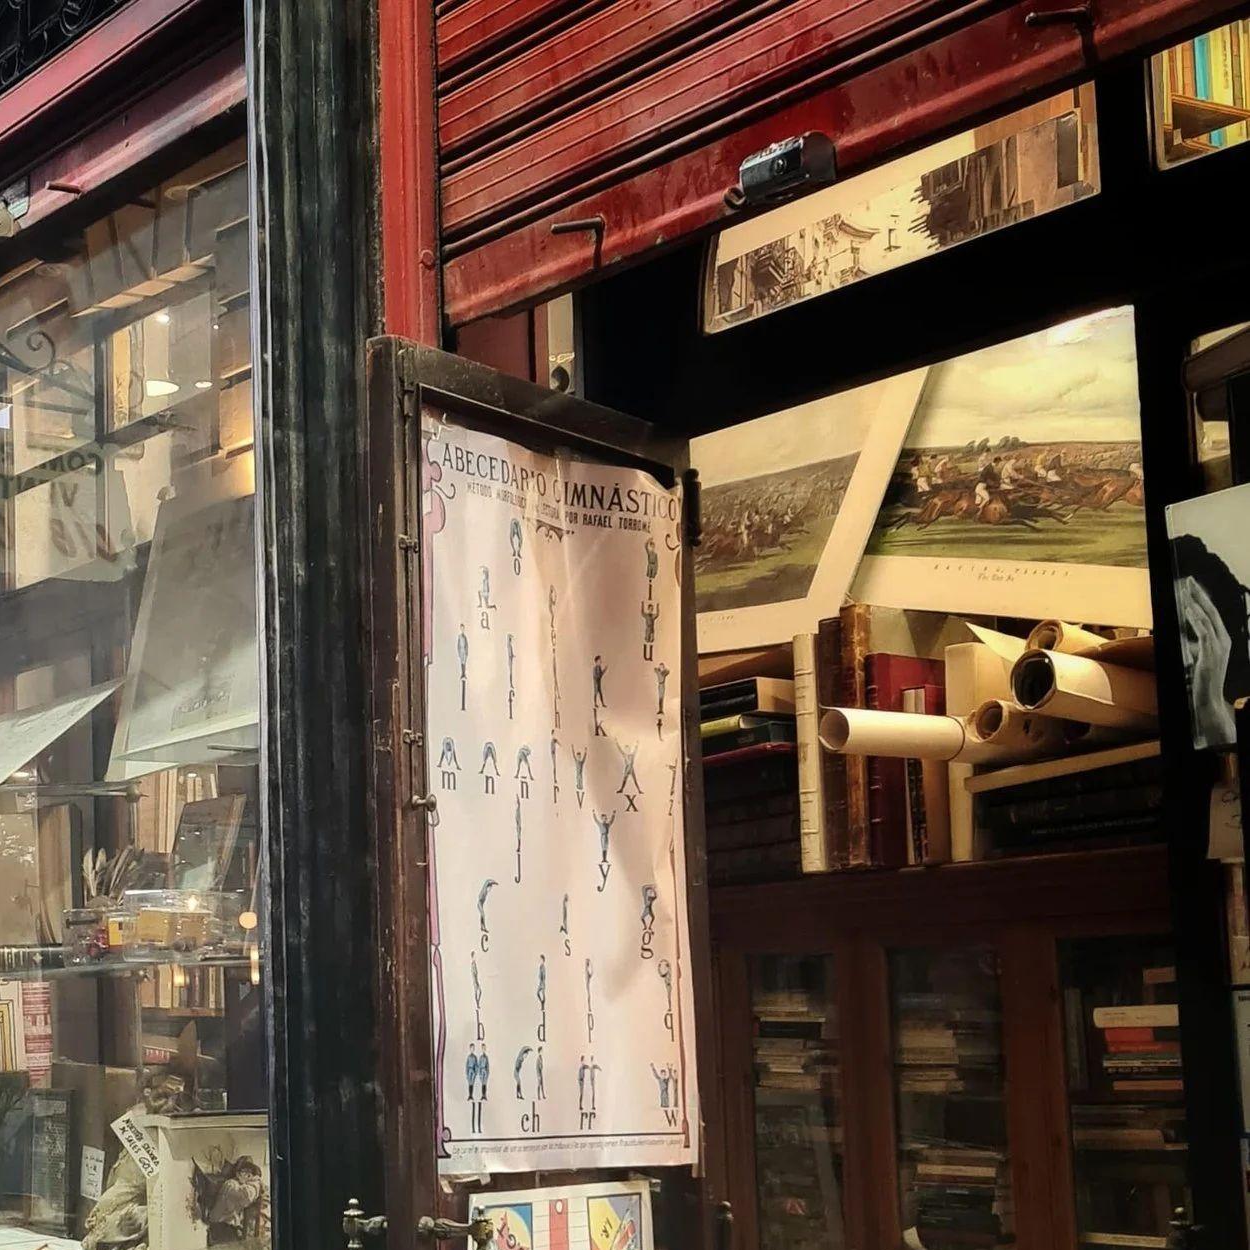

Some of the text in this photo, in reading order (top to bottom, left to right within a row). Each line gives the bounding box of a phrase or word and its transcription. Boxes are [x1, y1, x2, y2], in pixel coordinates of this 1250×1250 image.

[582, 513, 612, 529] RAFAEL
[514, 558, 521, 576] o
[480, 612, 490, 630] a
[643, 643, 653, 662] u
[508, 690, 515, 719] f
[593, 707, 608, 737] k
[656, 718, 664, 742] t
[441, 770, 456, 790] m
[485, 775, 495, 795] n
[520, 776, 529, 799] ñ
[553, 785, 560, 804] r
[576, 790, 585, 809] v
[624, 794, 639, 812] x
[514, 853, 521, 884] j
[597, 863, 611, 892] y
[480, 934, 489, 953] c
[564, 938, 571, 956] s
[640, 930, 654, 960] g
[476, 1009, 485, 1041] b
[537, 1011, 546, 1042] d
[587, 1013, 594, 1043] p
[664, 1012, 674, 1042] q
[521, 1101, 540, 1133] ch
[579, 1109, 596, 1131] rr
